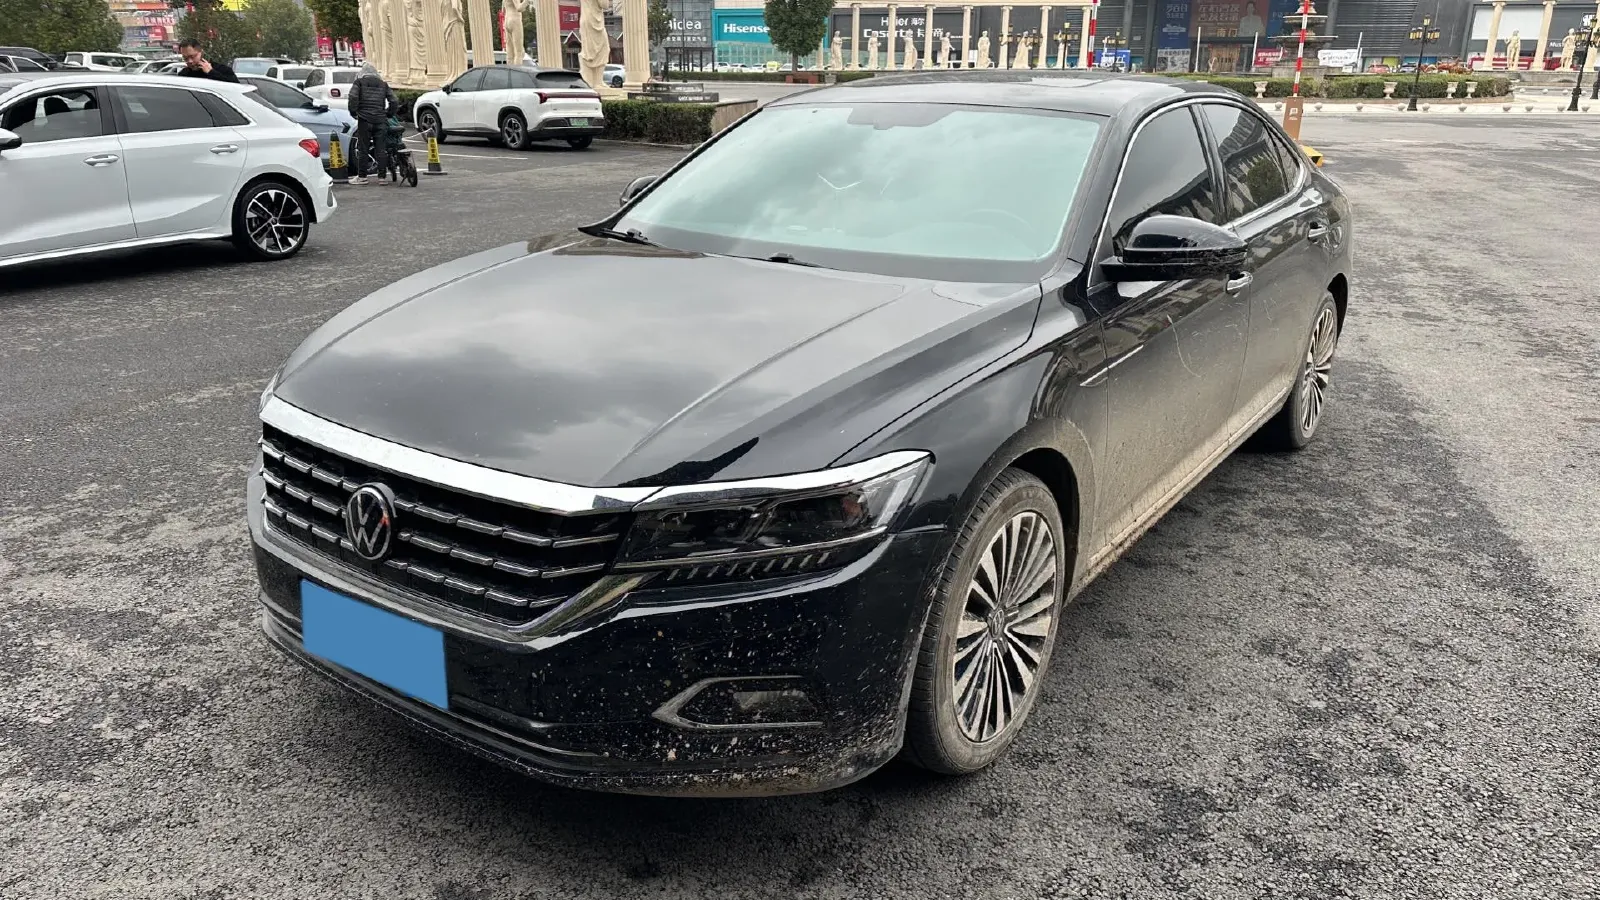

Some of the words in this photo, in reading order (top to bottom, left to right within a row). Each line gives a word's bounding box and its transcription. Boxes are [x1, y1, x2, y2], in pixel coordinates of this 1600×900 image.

[881, 17, 909, 26] Hier
[723, 23, 770, 33] Hisense
[917, 28, 944, 38] 卡帝
